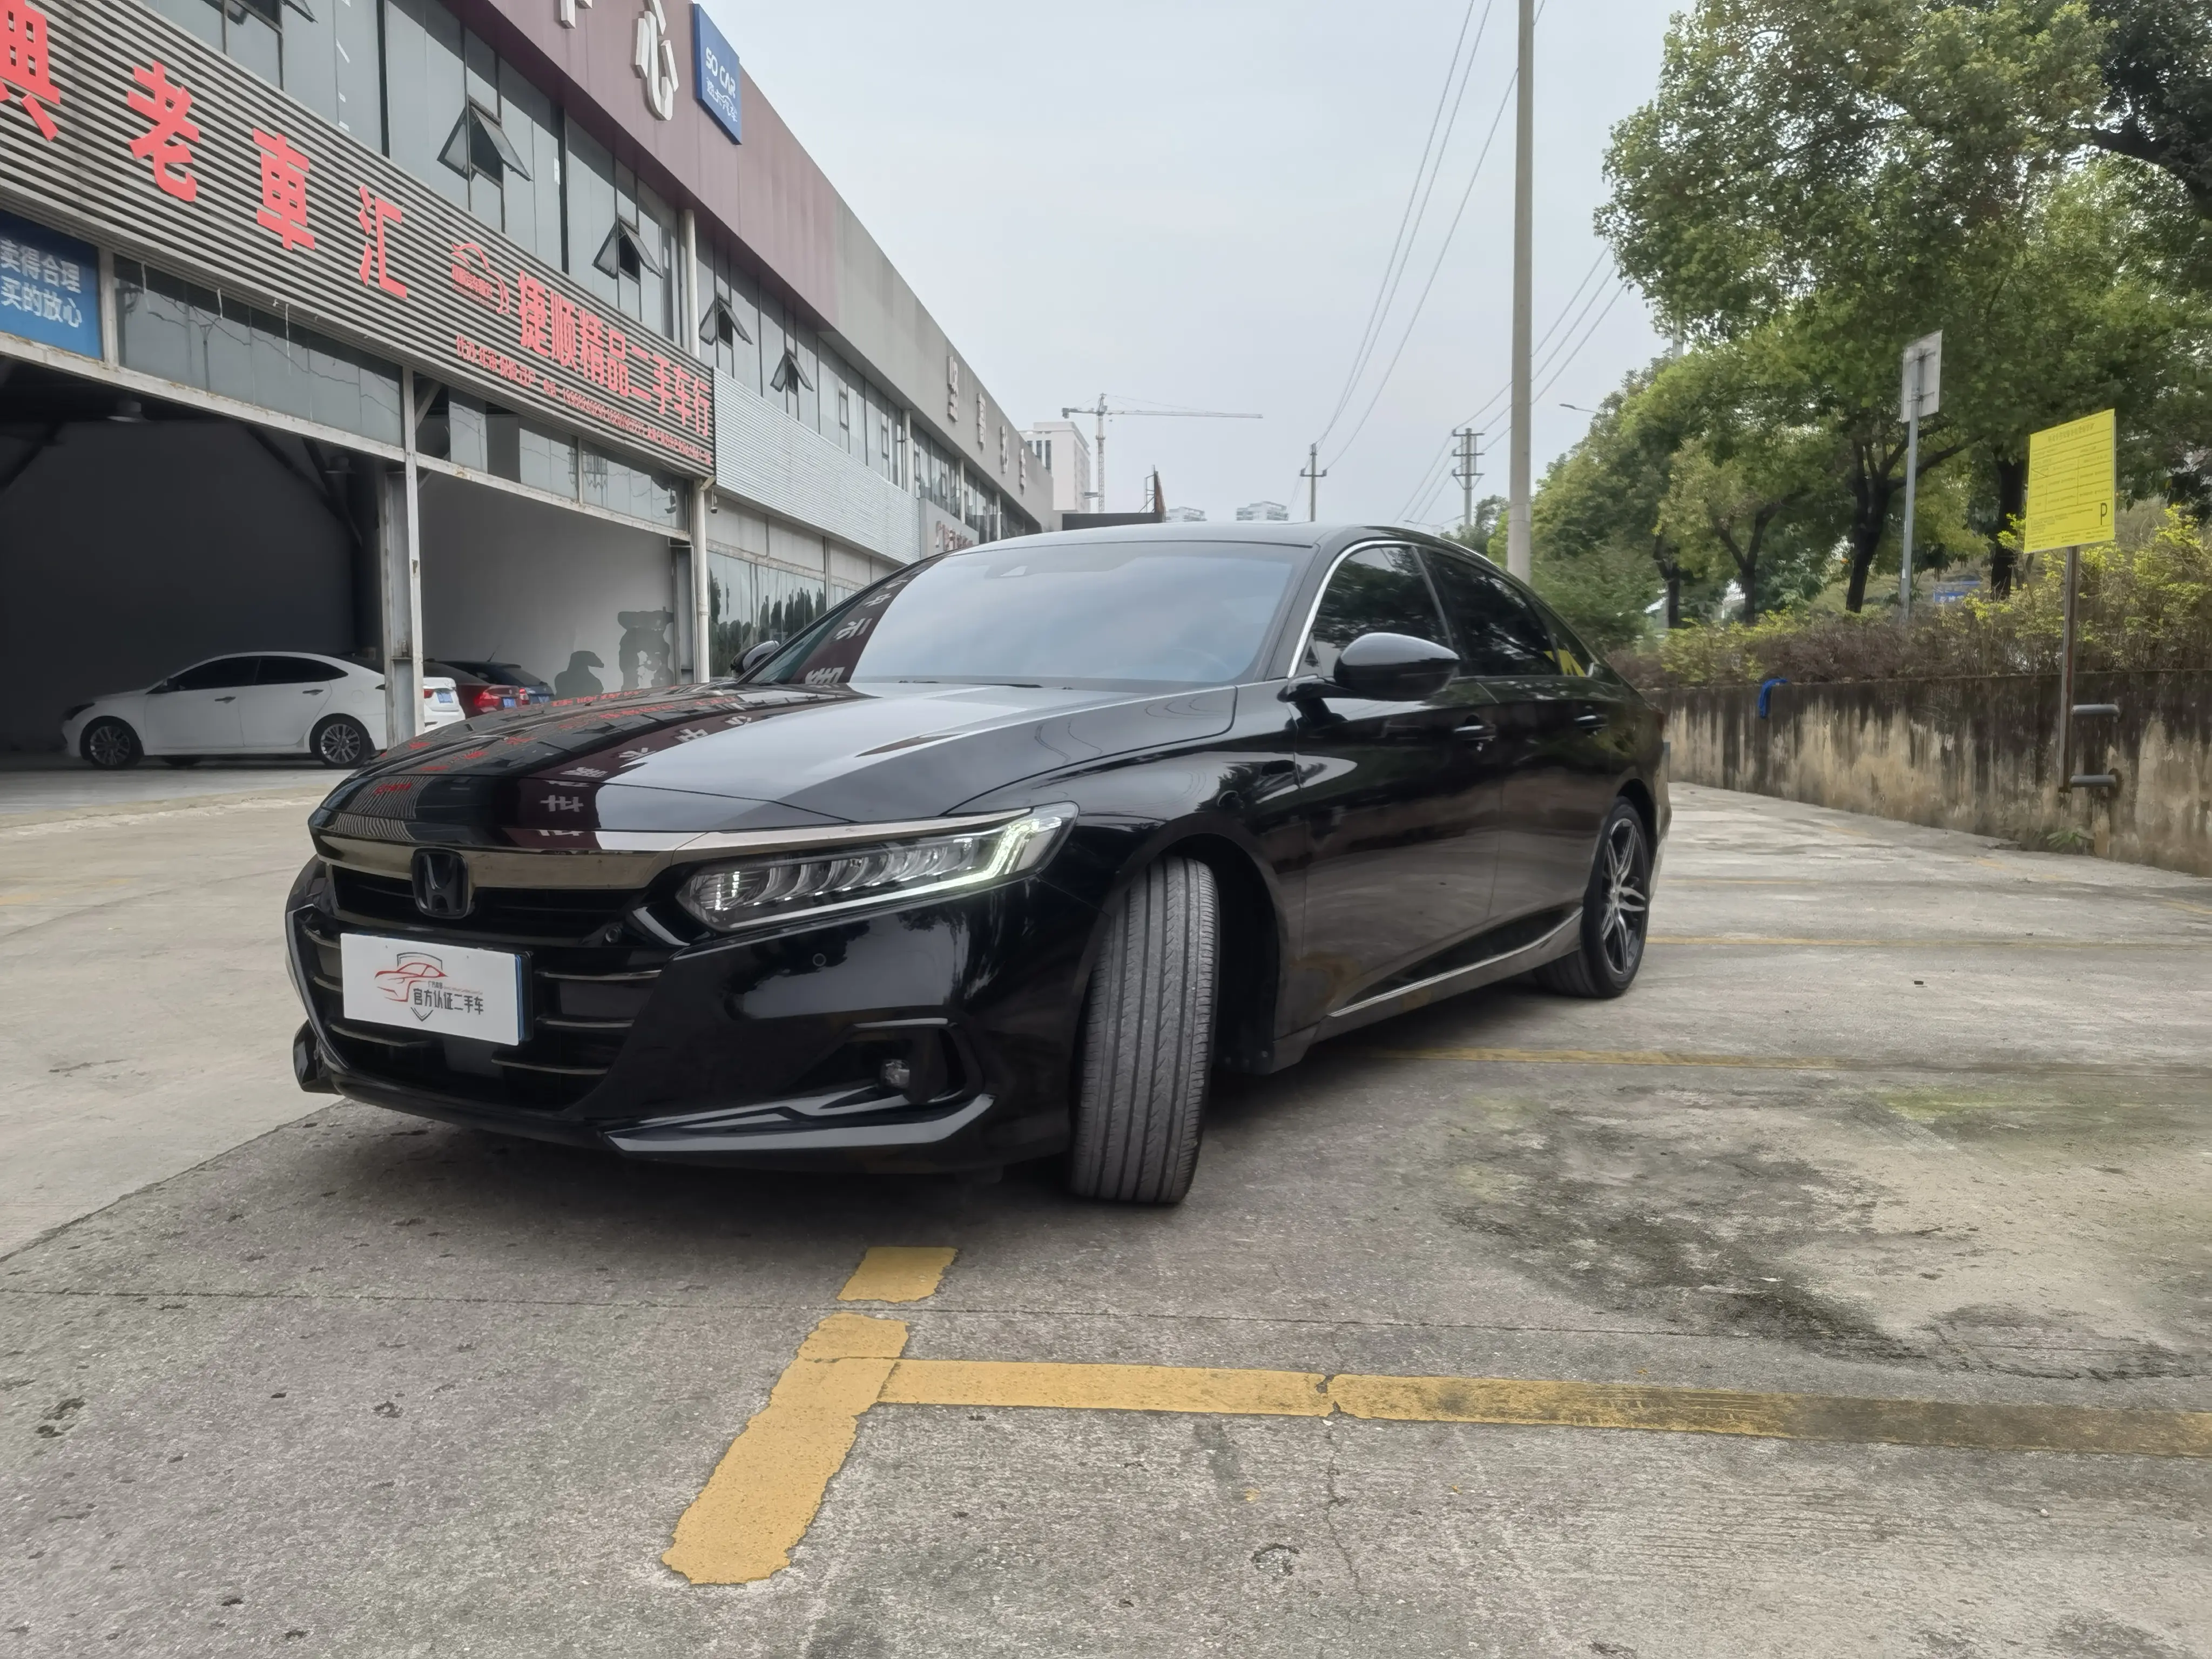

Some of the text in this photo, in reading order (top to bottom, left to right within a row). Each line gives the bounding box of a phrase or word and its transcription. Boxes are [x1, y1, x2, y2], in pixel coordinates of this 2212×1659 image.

[706, 47, 718, 77] SO
[719, 65, 736, 99] CAR
[1, 275, 83, 328] 买的放心
[518, 269, 709, 436] 捷顺精品二手车行
[2100, 502, 2108, 526] P
[413, 988, 484, 1015] 官方认证二手车
